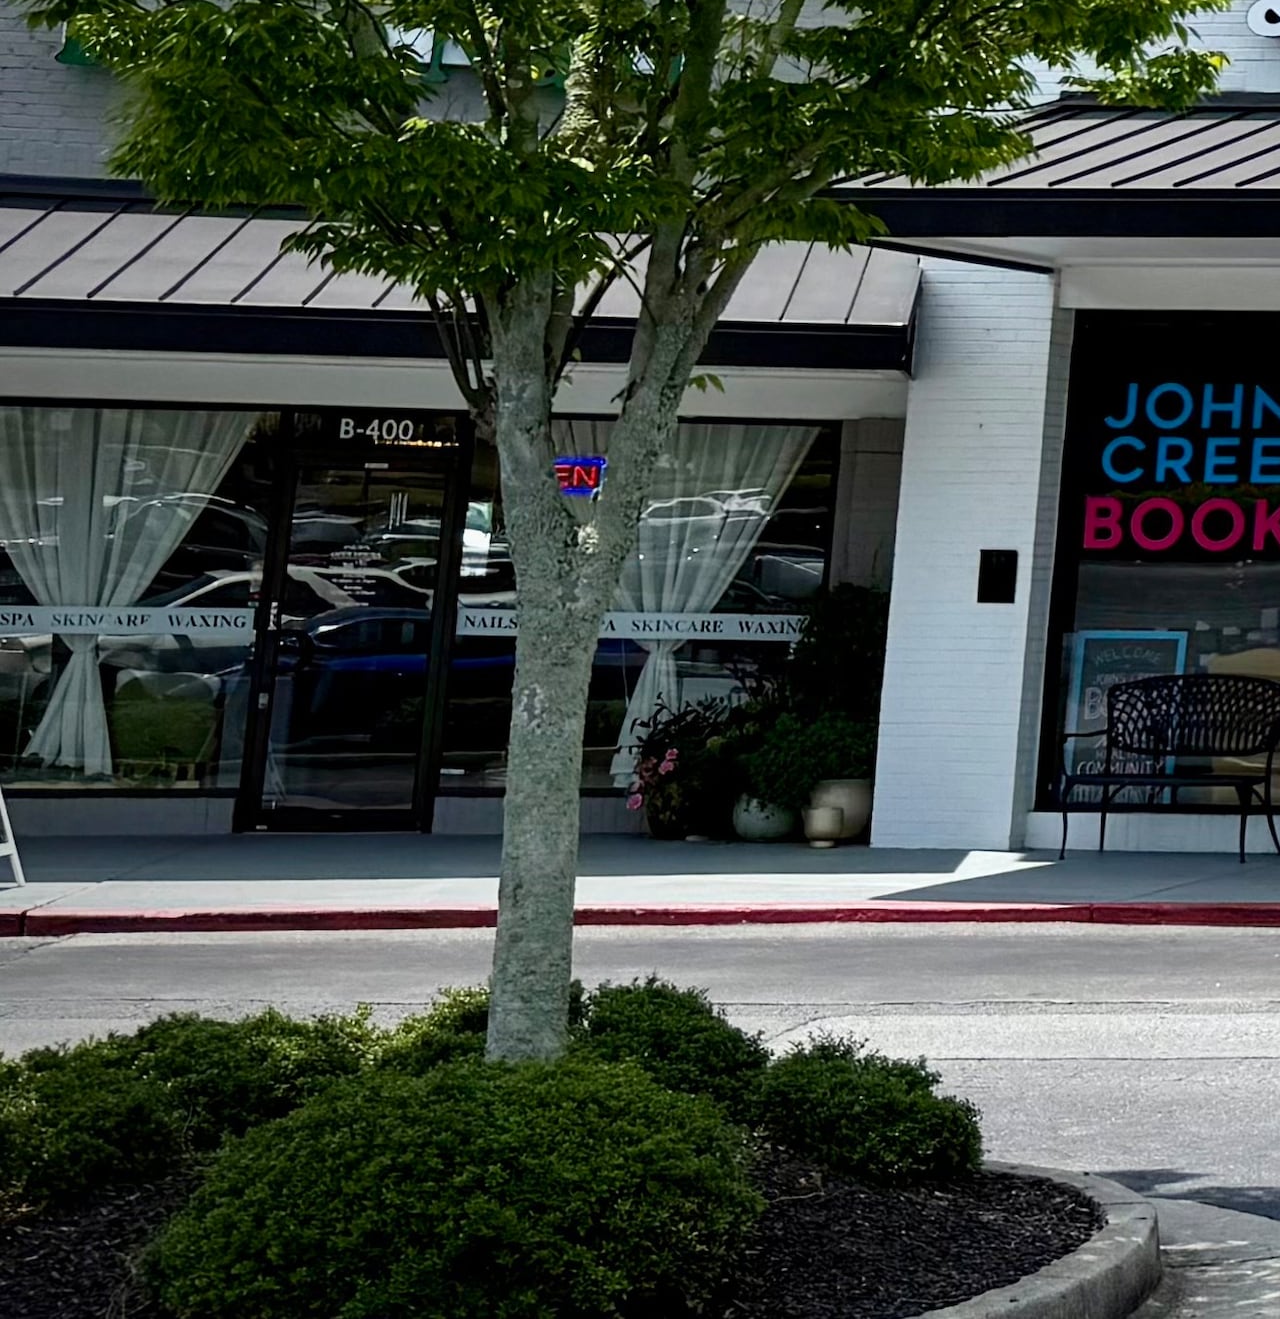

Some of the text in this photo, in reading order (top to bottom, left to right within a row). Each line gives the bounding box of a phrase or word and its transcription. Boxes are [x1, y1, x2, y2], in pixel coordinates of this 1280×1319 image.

[339, 418, 414, 440] B-400
[0, 613, 247, 628] SPA SKINCARE WAXING
[464, 615, 518, 630] NAILS
[632, 620, 724, 634] SKINCARE
